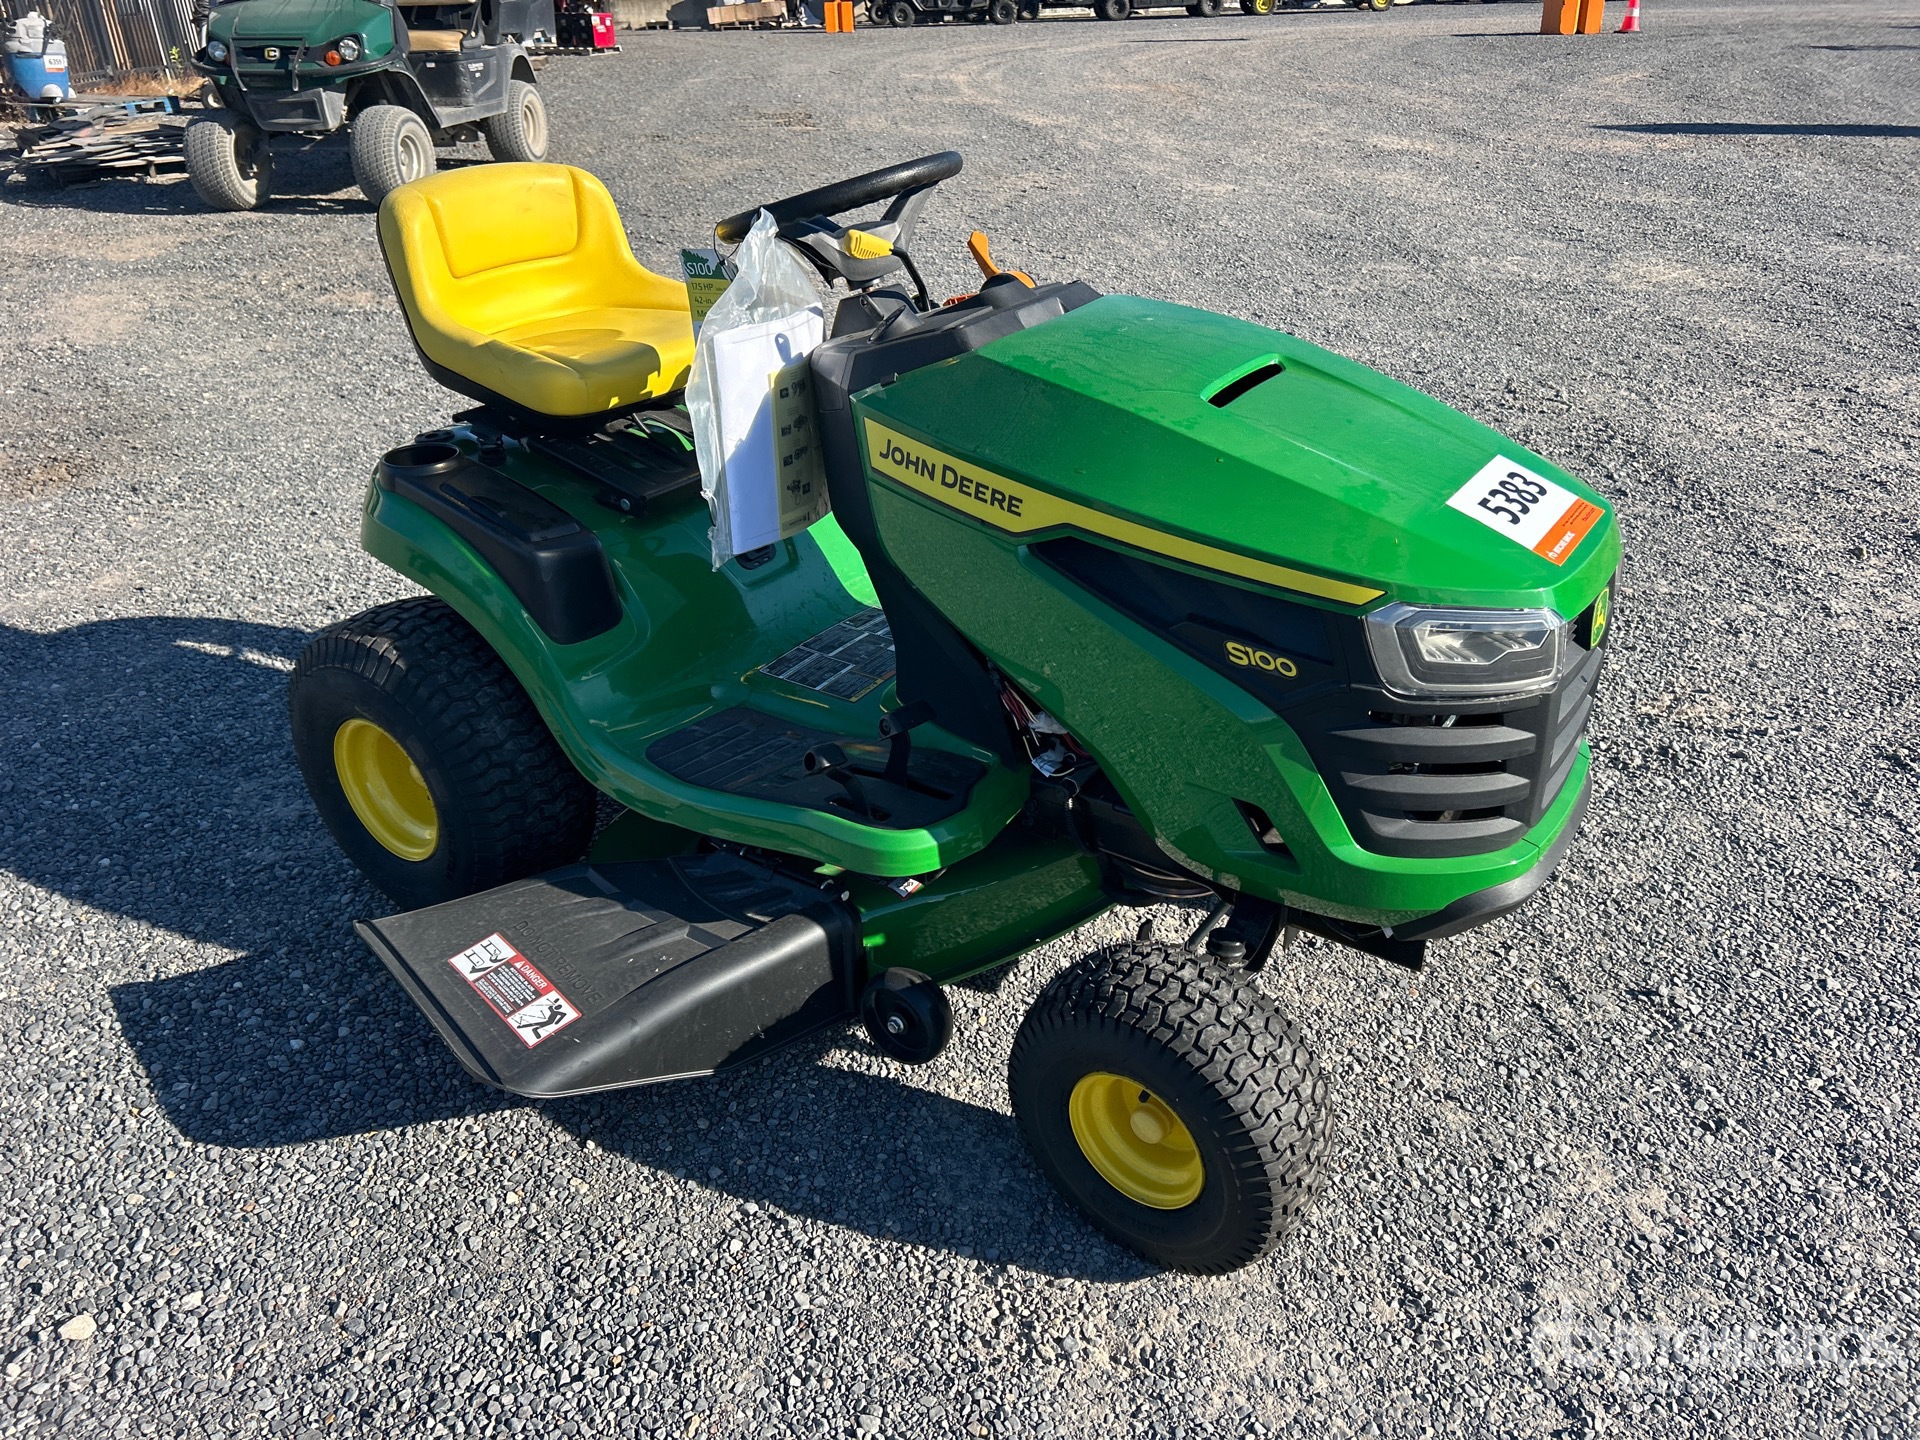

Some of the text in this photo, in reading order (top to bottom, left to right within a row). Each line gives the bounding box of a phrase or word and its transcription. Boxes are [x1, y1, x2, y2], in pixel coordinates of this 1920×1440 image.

[686, 262, 713, 276] S100
[703, 283, 714, 291] HP
[879, 438, 1024, 518] JOHN DEERE
[1476, 471, 1548, 525] 5383
[1225, 641, 1298, 678] S100
[513, 920, 537, 938] DO
[528, 936, 559, 959] NOT
[551, 956, 606, 1005] REMOVE
[520, 964, 548, 990] DANGER
